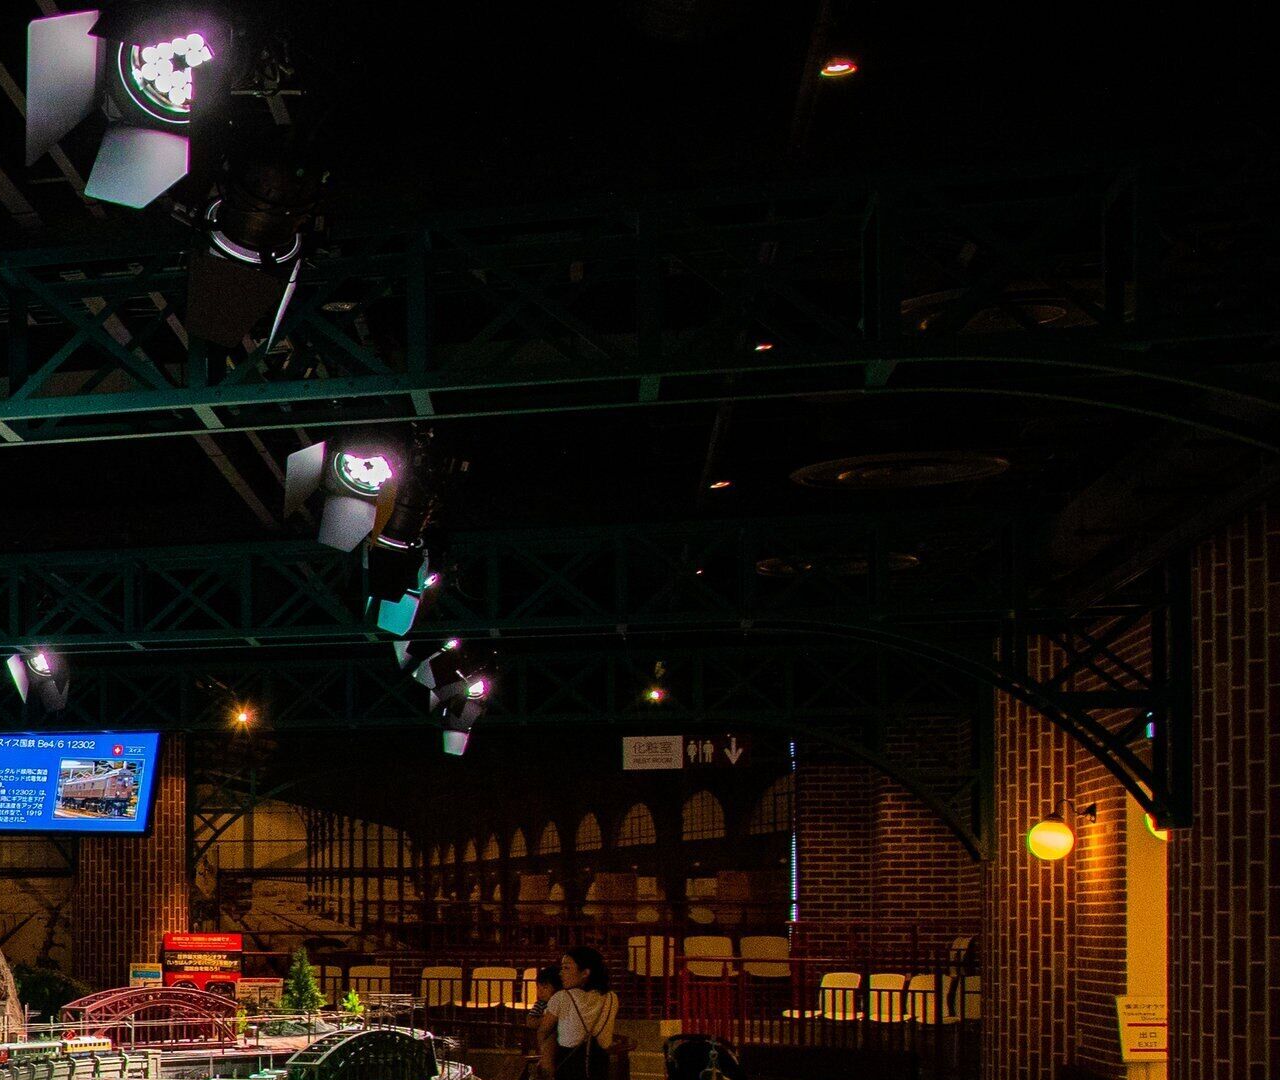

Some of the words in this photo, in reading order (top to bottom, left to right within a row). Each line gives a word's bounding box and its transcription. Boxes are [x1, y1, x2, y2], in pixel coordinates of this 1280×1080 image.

[37, 740, 64, 749] Be4/6
[67, 740, 95, 750] 12302
[1139, 1031, 1157, 1039] 出口
